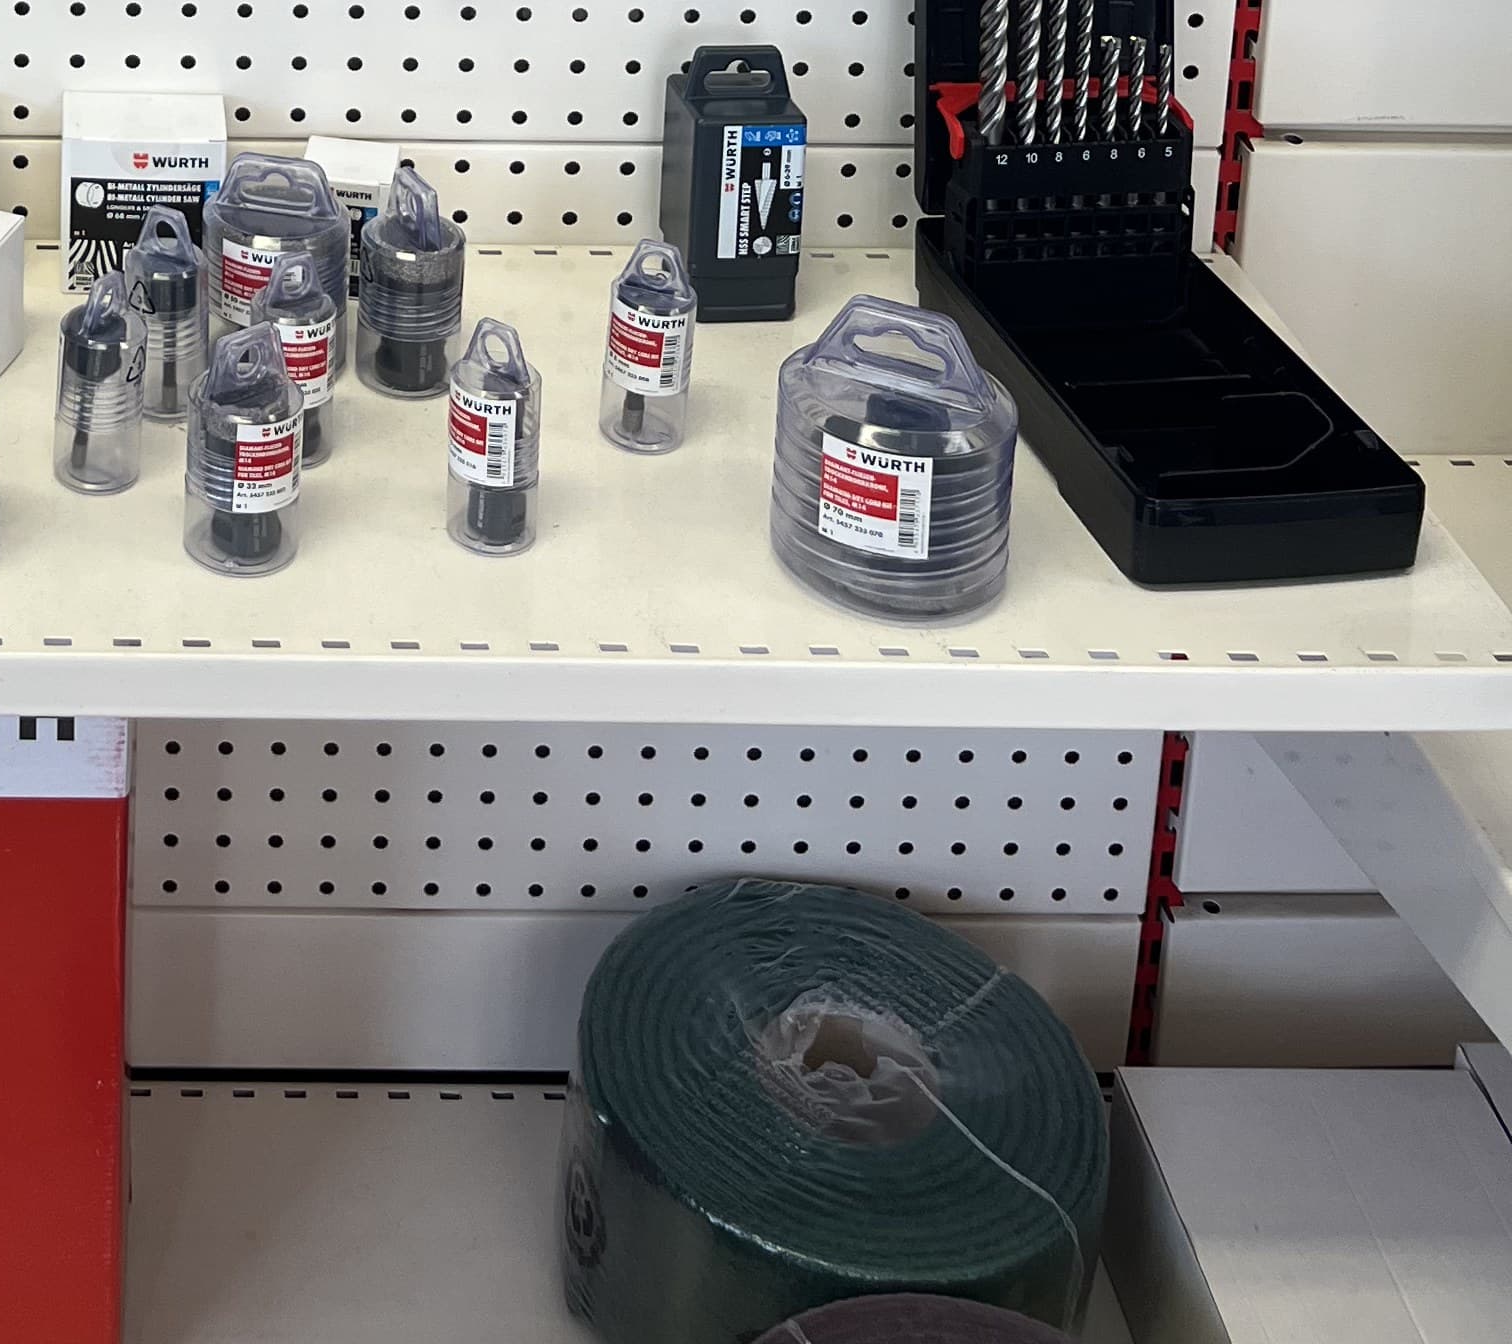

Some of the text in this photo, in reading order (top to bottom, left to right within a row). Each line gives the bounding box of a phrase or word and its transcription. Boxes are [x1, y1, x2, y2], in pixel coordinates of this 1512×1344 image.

[152, 157, 208, 168] WÜRTH
[726, 130, 737, 180] WÜRTH
[995, 147, 1172, 165] 12 10 8 6 8 6 5
[147, 194, 182, 203] CYLINDER
[183, 195, 200, 203] SAW
[336, 188, 373, 201] WÜRTH
[738, 182, 751, 255] HSS SMART STEP
[638, 317, 686, 330] WÜRTH
[462, 396, 512, 416] WÜRTH
[861, 452, 925, 472] WÜRTH
